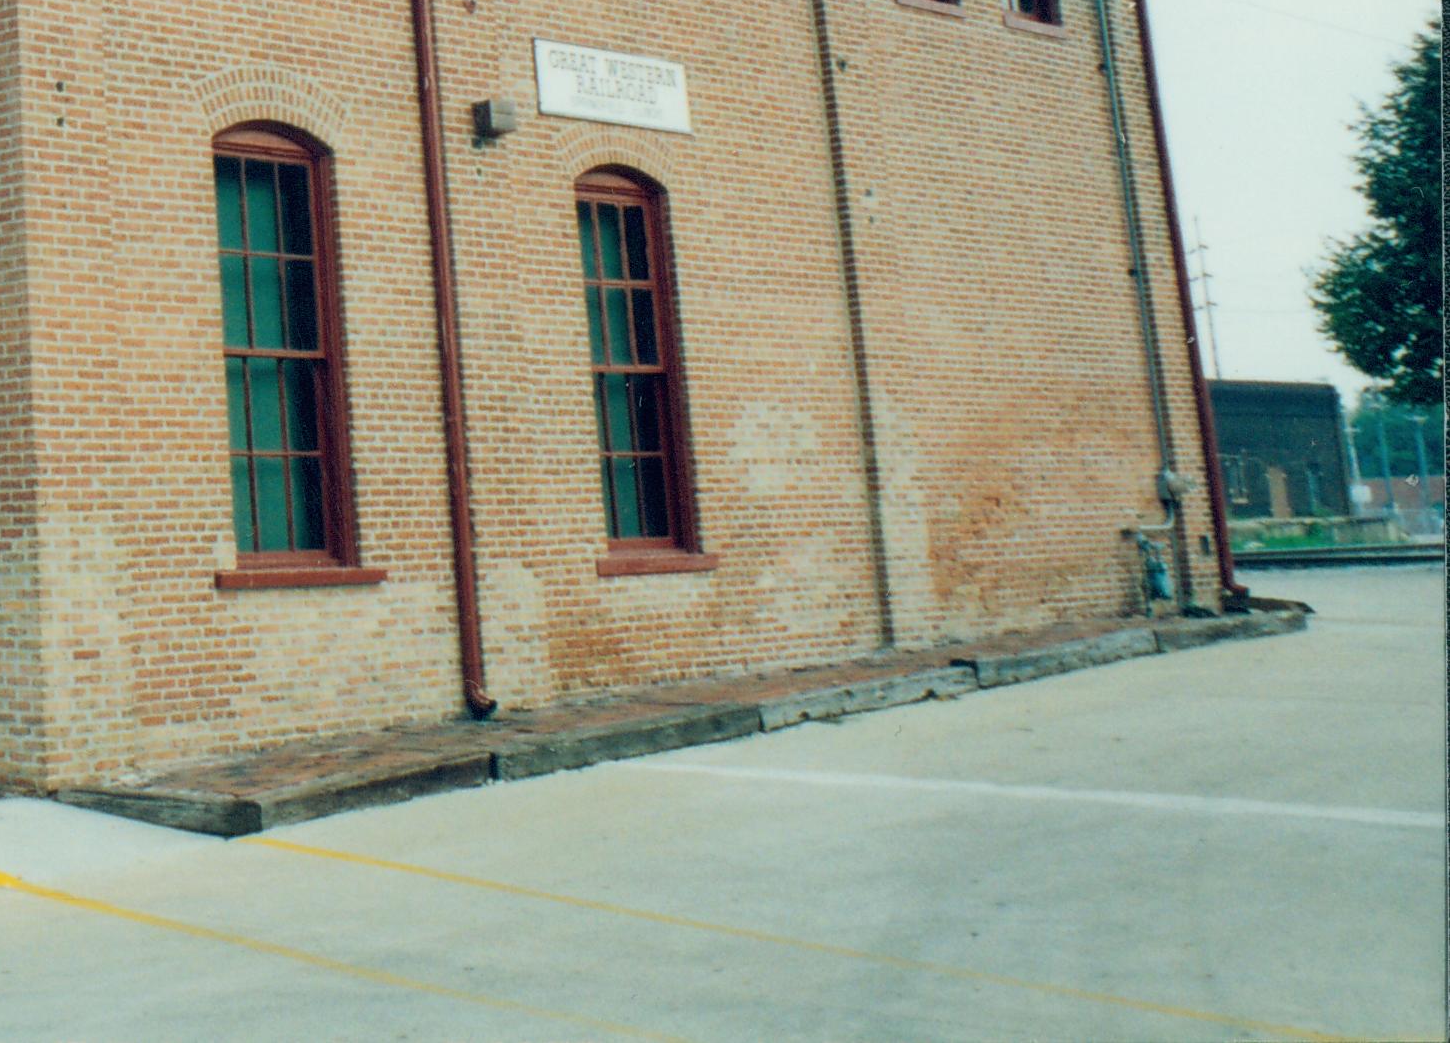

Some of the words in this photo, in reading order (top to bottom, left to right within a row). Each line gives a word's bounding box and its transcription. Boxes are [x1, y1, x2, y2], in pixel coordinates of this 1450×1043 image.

[549, 49, 598, 75] GREAT
[603, 58, 677, 88] WESTERN
[576, 74, 658, 105] RAILROAD
